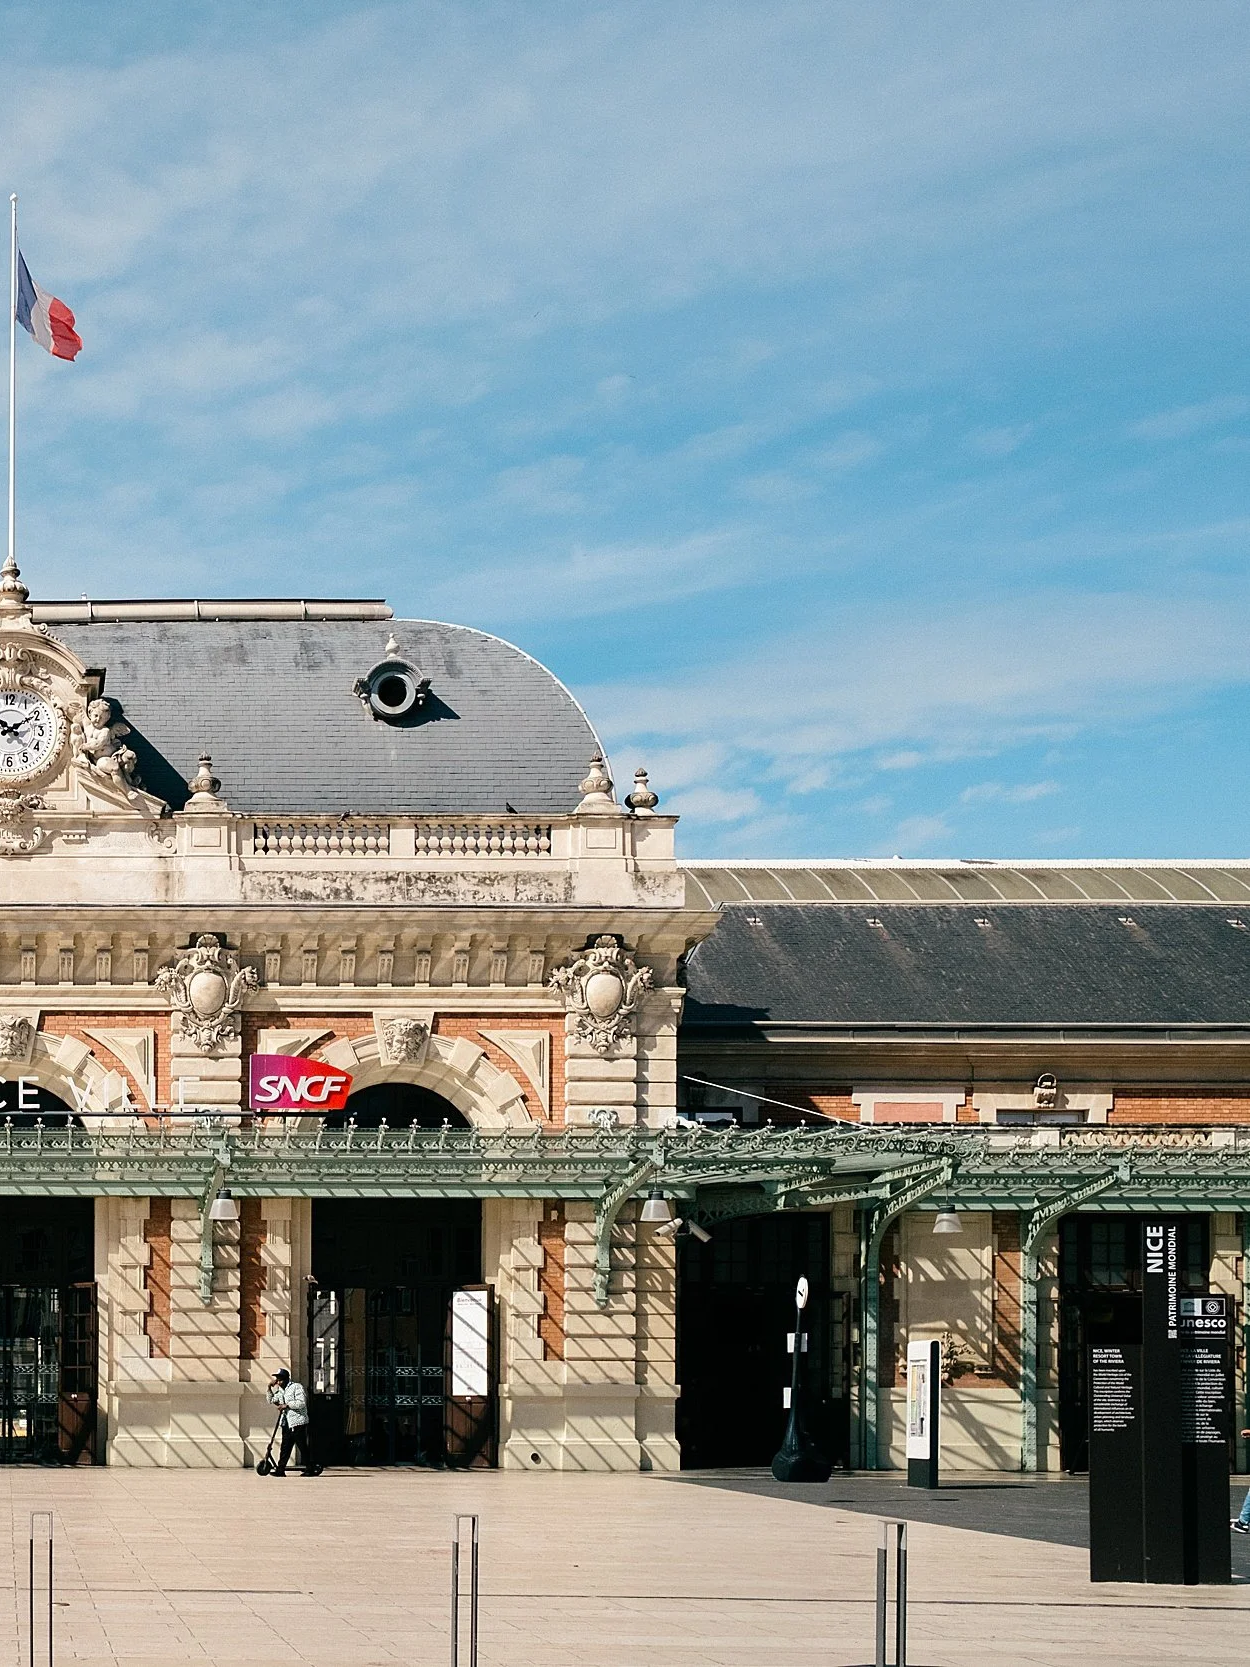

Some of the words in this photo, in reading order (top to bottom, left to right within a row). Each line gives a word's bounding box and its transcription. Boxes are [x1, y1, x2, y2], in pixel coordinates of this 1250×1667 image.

[5, 694, 15, 705] 12
[34, 710, 40, 720] 2
[38, 726, 44, 737] 3
[34, 741, 40, 751] 4
[6, 757, 13, 767] 6
[22, 752, 28, 763] 5
[66, 1075, 200, 1109] VILLE
[254, 1075, 347, 1102] SNCF
[1146, 1226, 1164, 1273] NICE
[1168, 1226, 1176, 1270] MONDIAL
[1168, 1272, 1176, 1326] PATRIMOINE
